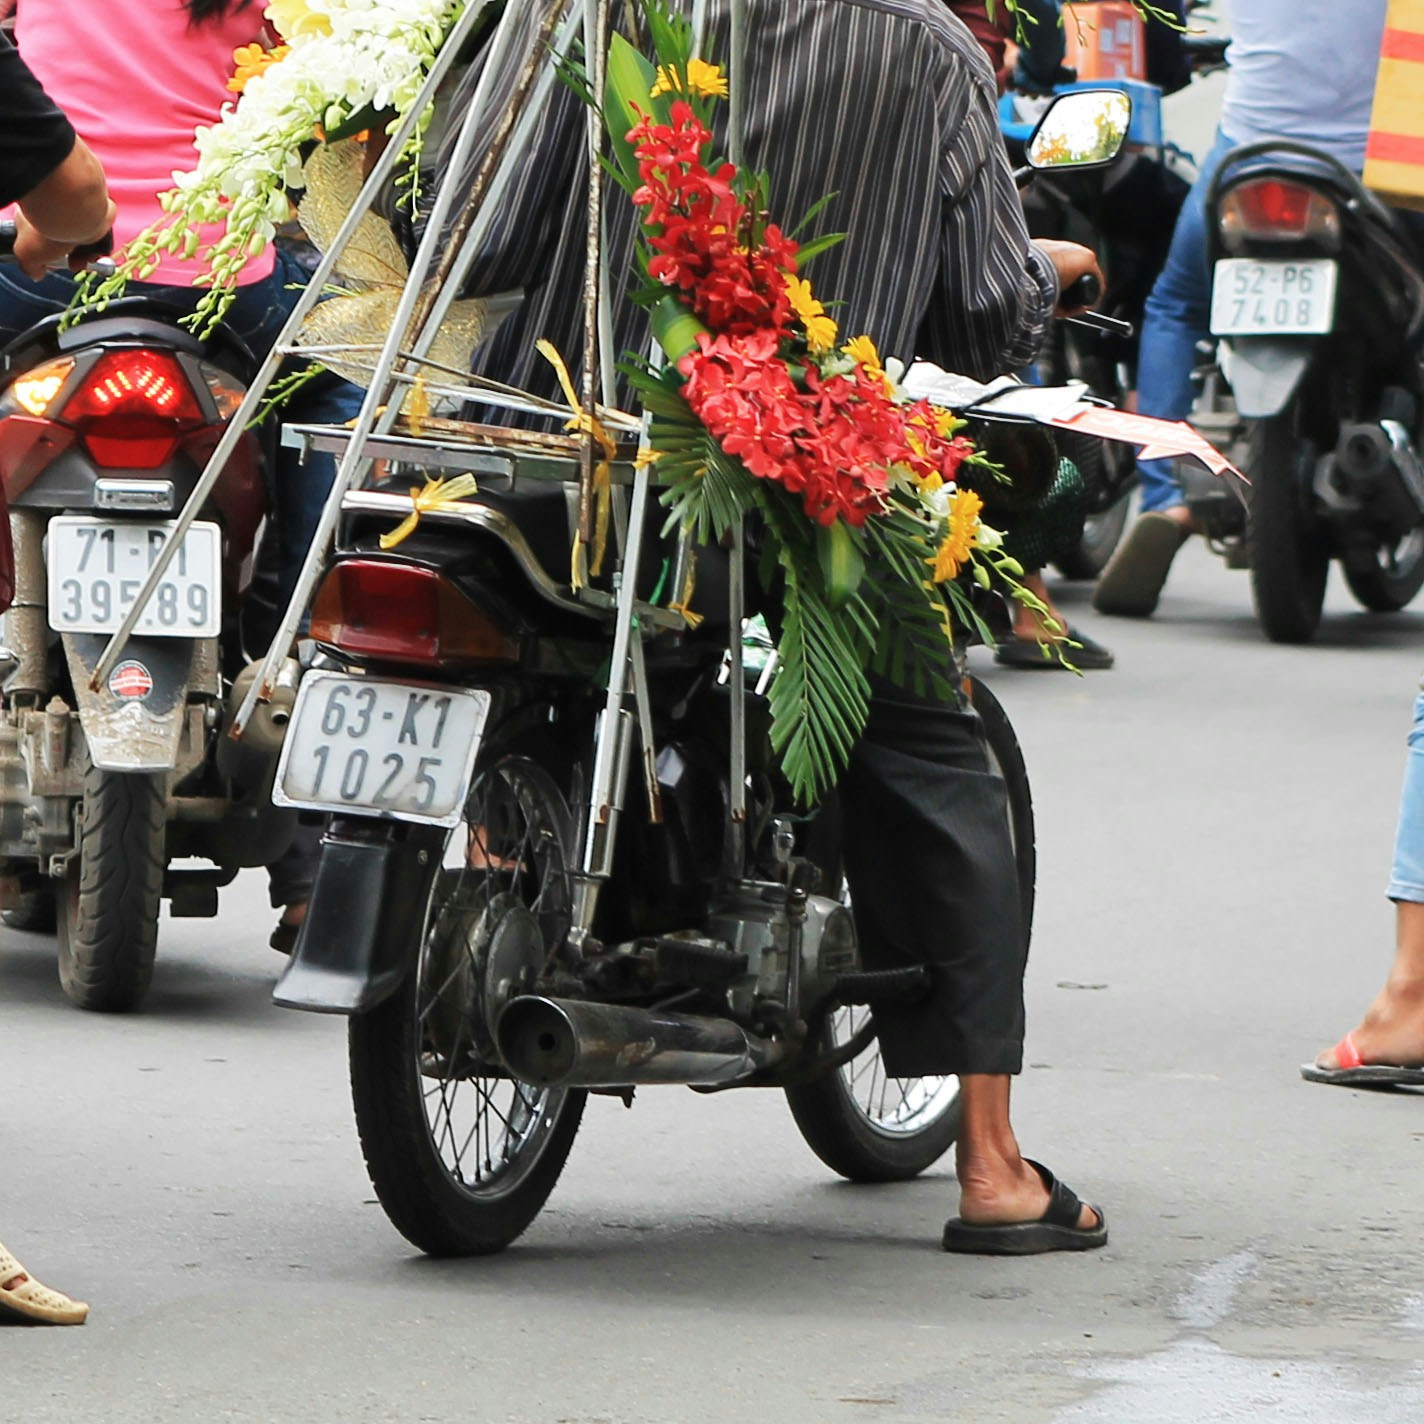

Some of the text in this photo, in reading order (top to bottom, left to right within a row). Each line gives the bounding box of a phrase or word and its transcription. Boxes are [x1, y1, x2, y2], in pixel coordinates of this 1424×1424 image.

[1234, 266, 1313, 294] 52-P6
[1231, 299, 1310, 327] 7408
[61, 578, 208, 626] 395.89
[320, 683, 453, 749] 63-K1
[311, 743, 443, 812] 1025
